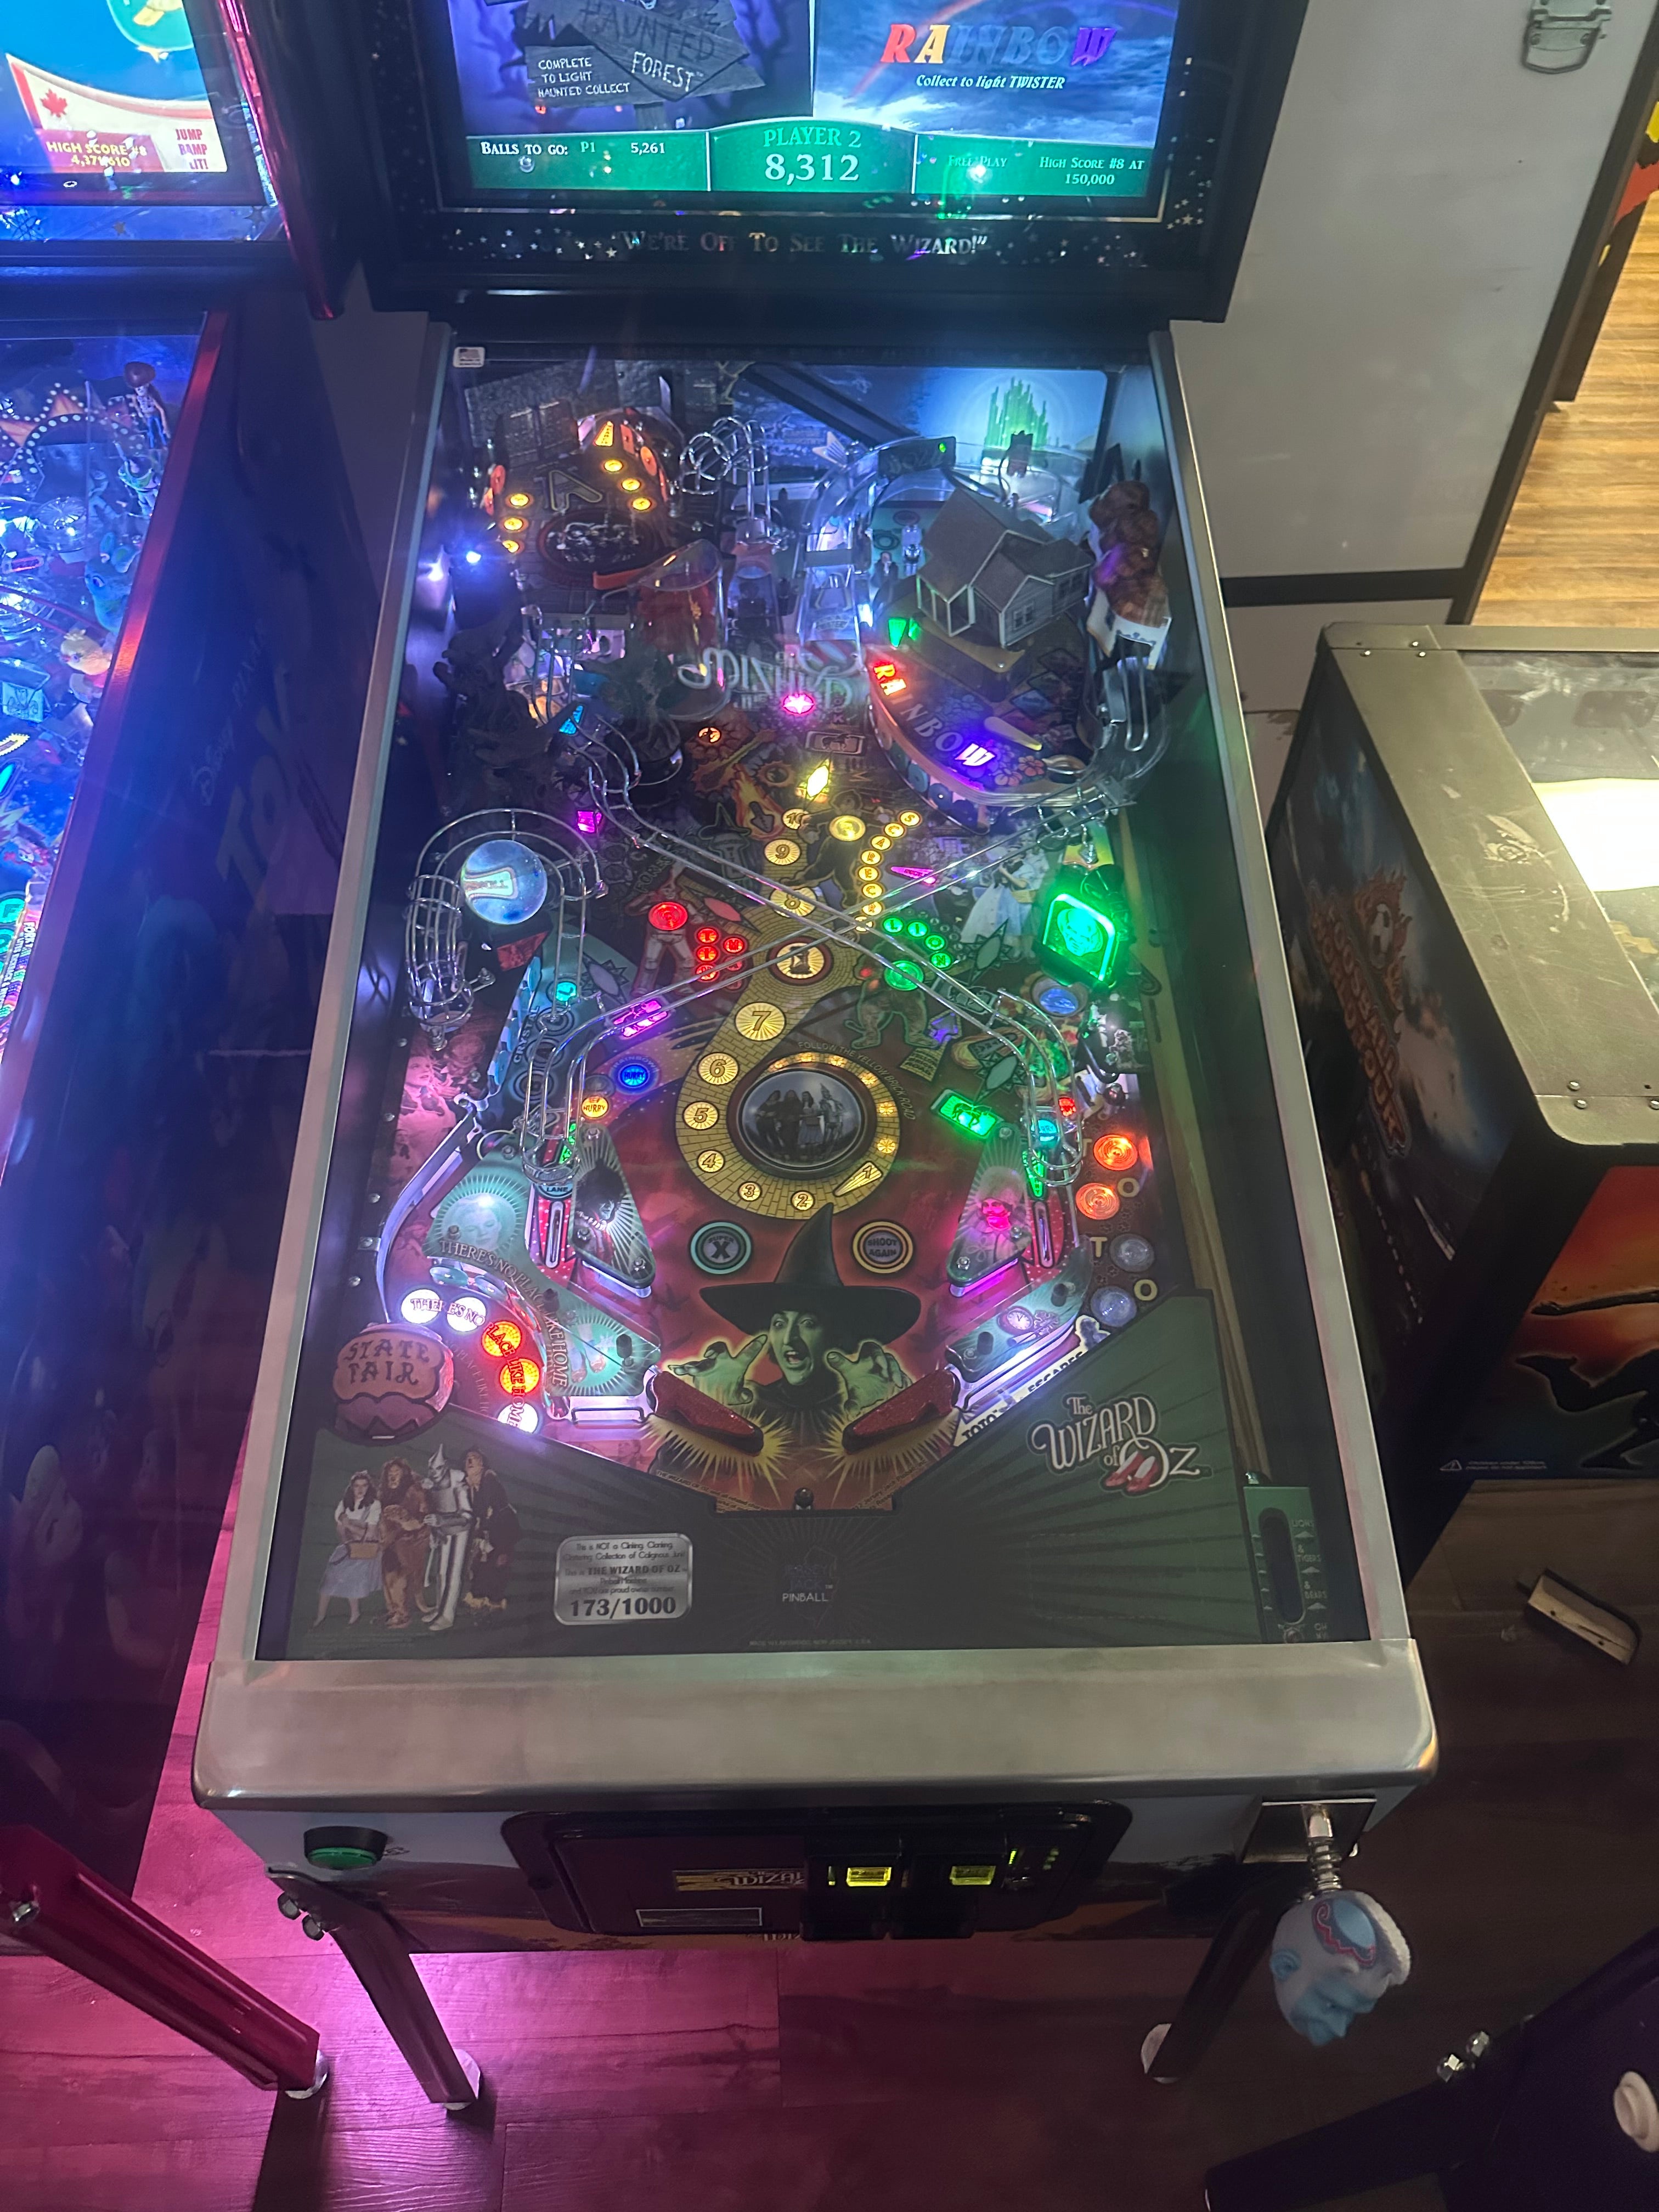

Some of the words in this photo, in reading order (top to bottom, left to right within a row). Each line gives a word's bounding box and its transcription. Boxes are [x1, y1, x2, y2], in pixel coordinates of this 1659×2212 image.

[881, 24, 1117, 65] RAINBOW
[538, 57, 592, 69] COMPLETE
[541, 71, 556, 83] TO
[558, 71, 592, 82] LIGHT
[631, 50, 695, 93] FOREST
[538, 86, 583, 98] HAUNTED
[585, 82, 630, 95] COLLECT
[916, 75, 957, 88] Collect
[961, 76, 973, 88] to
[975, 75, 1005, 90] light
[1009, 76, 1065, 89] TWISTER
[176, 129, 203, 140] JUMP
[764, 126, 840, 147] PLAYER
[850, 131, 861, 148] 2
[47, 142, 81, 154] HIGH
[84, 144, 127, 156] SCORE
[580, 142, 596, 154] P1
[631, 142, 665, 156] 5,261
[765, 153, 860, 185] 8,312
[1109, 158, 1124, 170] #8
[1065, 173, 1115, 187] 150,000
[776, 844, 791, 860] 9
[751, 1011, 771, 1031] 7
[514, 1006, 539, 1063] CRYSTAL
[711, 1059, 725, 1076] 6
[798, 1041, 837, 1052] FOLLOW
[839, 1046, 856, 1057] THE
[856, 1053, 889, 1077] YELLOW
[885, 1074, 907, 1097] BRICK
[899, 1097, 916, 1120] ROAD
[695, 1108, 709, 1123] 5
[702, 1154, 716, 1167] 4
[744, 1184, 754, 1198] 3
[798, 1194, 808, 1206] 2
[710, 1241, 731, 1260] X
[867, 1238, 898, 1247] SHOOT
[868, 1248, 897, 1257] AGAIN
[439, 1240, 495, 1267] THERE'S
[495, 1258, 517, 1279] NO
[550, 1340, 568, 1387] HOME
[410, 1298, 466, 1316] THERE'S
[464, 1307, 486, 1327] NO
[486, 1321, 516, 1358] PLACE
[343, 1339, 431, 1364] STATE
[348, 1361, 419, 1386] FAIR
[1067, 1397, 1093, 1417] The
[1031, 1396, 1156, 1470] WIZARD
[1104, 1447, 1119, 1467] of
[588, 1566, 607, 1576] THE
[610, 1565, 649, 1575] WIZARD
[651, 1565, 664, 1573] OF
[667, 1564, 681, 1573] OZ
[781, 1593, 830, 1602] PINBALL
[570, 1596, 676, 1620] 173/1000
